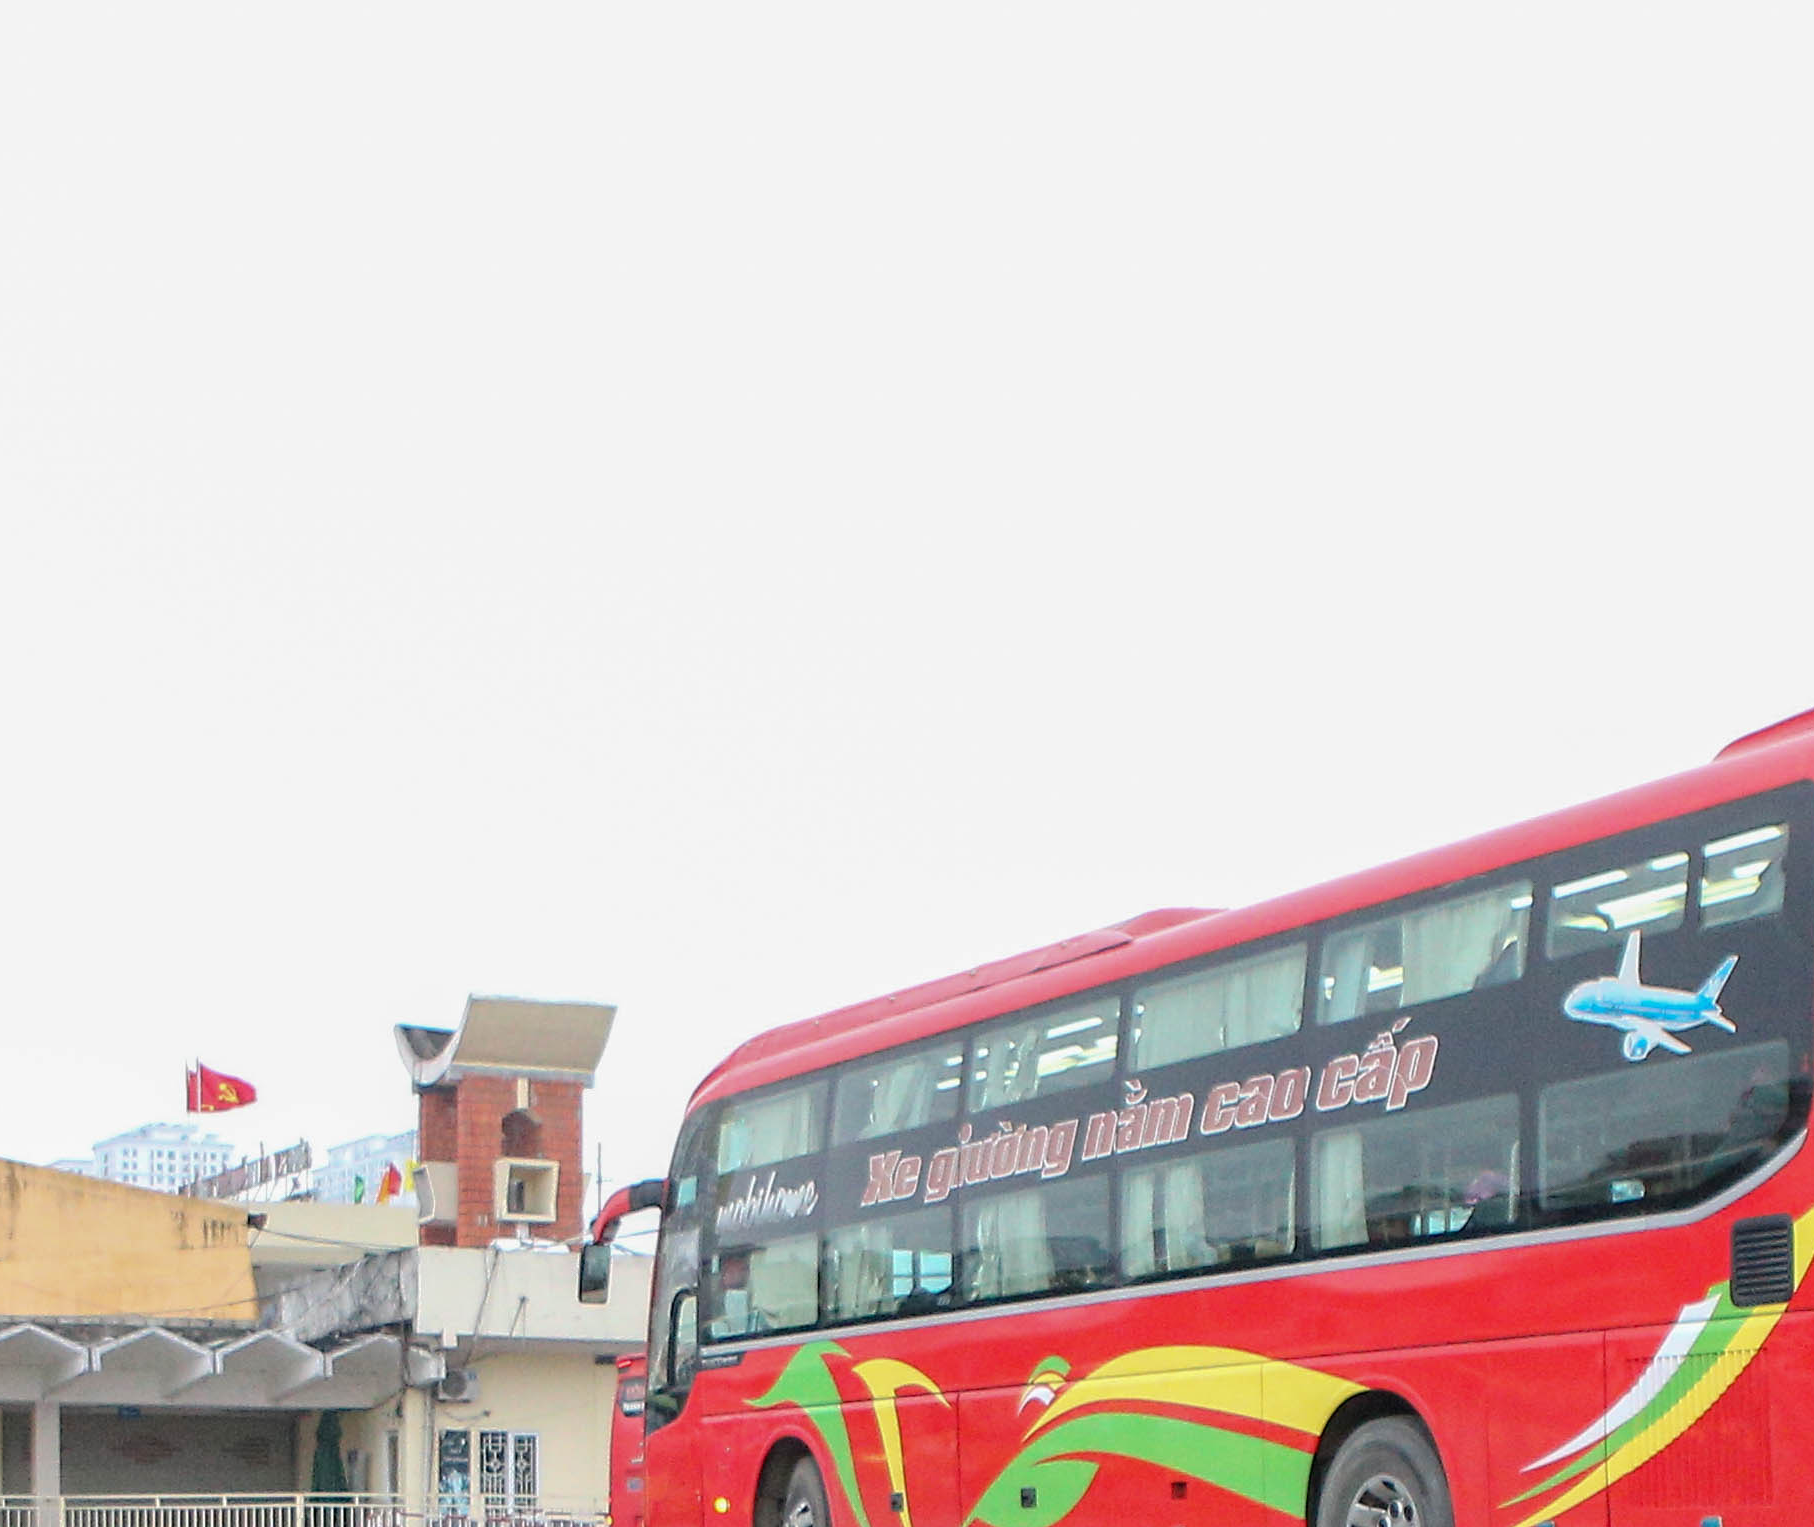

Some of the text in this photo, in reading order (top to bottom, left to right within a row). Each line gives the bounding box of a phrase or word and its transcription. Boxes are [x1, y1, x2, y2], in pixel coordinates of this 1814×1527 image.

[860, 1016, 1439, 1207] Xe giường nằm cao cấp
